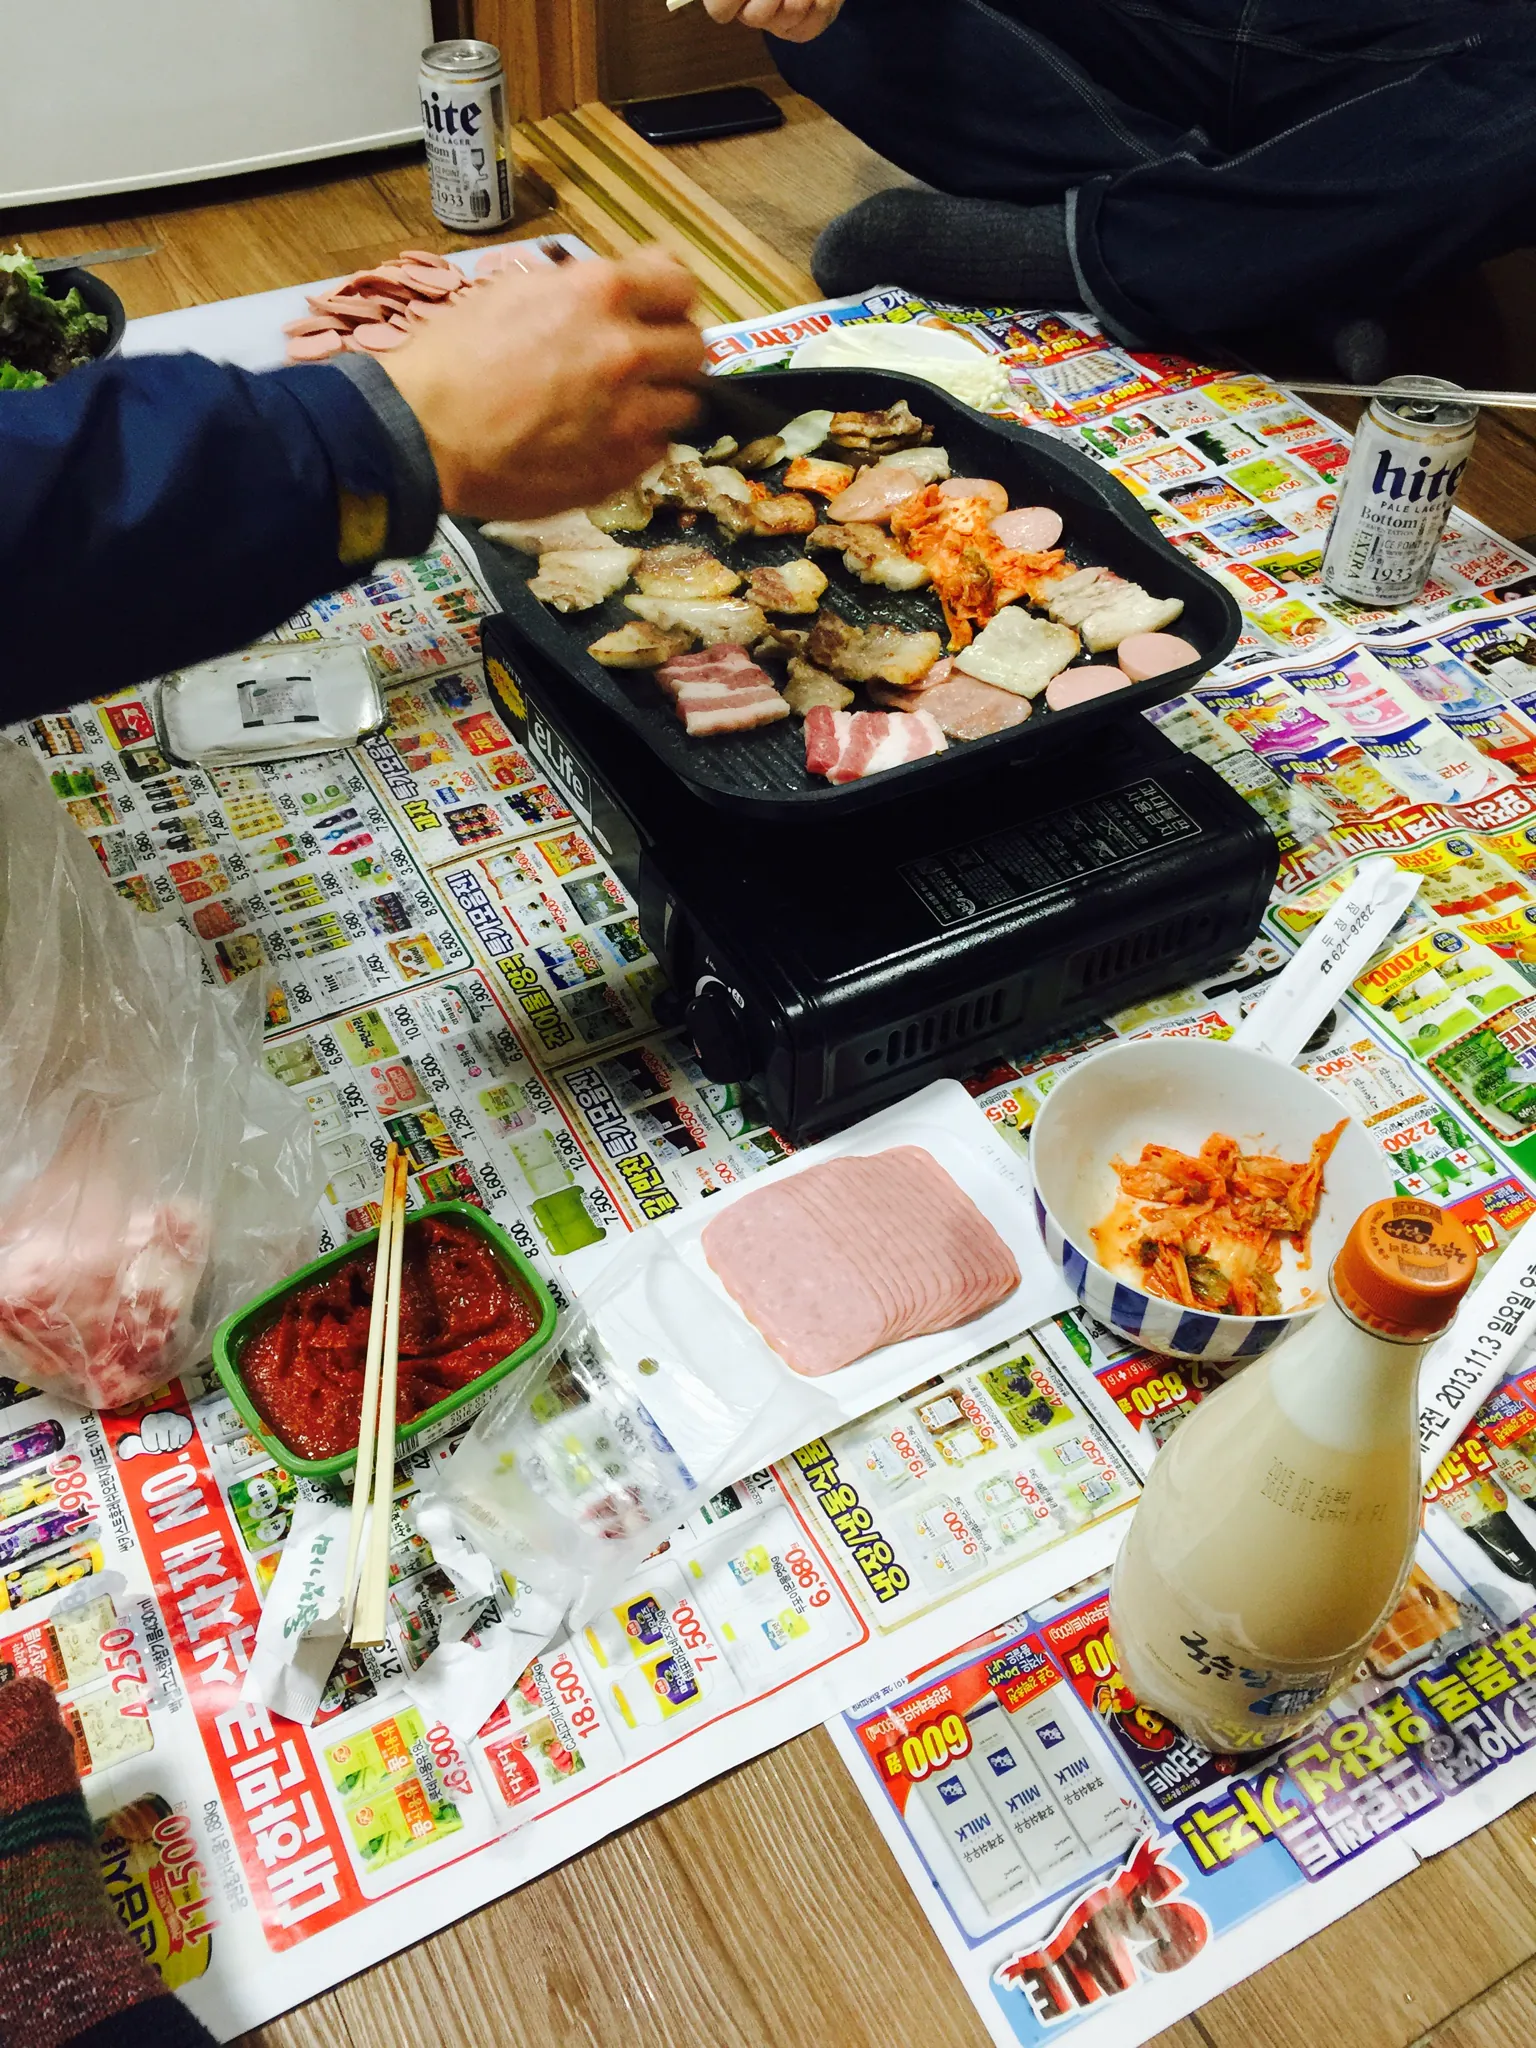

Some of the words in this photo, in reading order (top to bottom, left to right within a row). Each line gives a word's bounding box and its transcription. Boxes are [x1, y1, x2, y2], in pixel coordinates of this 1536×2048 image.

[435, 189, 464, 207] 1933
[1360, 505, 1418, 530] Bottom
[1381, 501, 1410, 514] PALE
[1347, 529, 1374, 580] EXTRA
[1371, 566, 1413, 583] 1933
[401, 799, 442, 833] 과자
[444, 868, 515, 957] 특가모음전!
[439, 930, 464, 959] 8,500
[1330, 903, 1377, 962] 621-9282
[293, 984, 313, 1006] 890
[468, 979, 495, 1013] 7,900
[496, 952, 575, 1051] 건어물/양곡
[393, 1003, 422, 1041] 10,900
[319, 1034, 344, 1067] 6,980
[497, 1029, 524, 1063] 6,980
[420, 1053, 451, 1094] 32,500
[343, 1083, 371, 1119] 7,500
[562, 1065, 638, 1158] 특가모음전!
[555, 1128, 588, 1172] 12,900
[1382, 1119, 1438, 1153] 2,200
[479, 1163, 508, 1200] 5,600
[614, 1150, 684, 1222] 갈/반찬
[589, 1186, 620, 1226] 7,500
[1446, 1333, 1501, 1410] 2013.11.3
[1488, 1290, 1522, 1340] 일요일
[1031, 1369, 1066, 1408] 4,600
[890, 1430, 926, 1480] 19,800
[1081, 1438, 1118, 1483] 9,450
[1013, 1474, 1050, 1519] 6,500
[943, 1509, 979, 1557] 9,500
[1053, 1755, 1091, 1787] MILK
[1005, 1784, 1042, 1815] MILK
[1281, 1758, 1438, 1877] 프로젝트
[954, 1811, 992, 1844] MILK
[1180, 1774, 1300, 1870] 가격!
